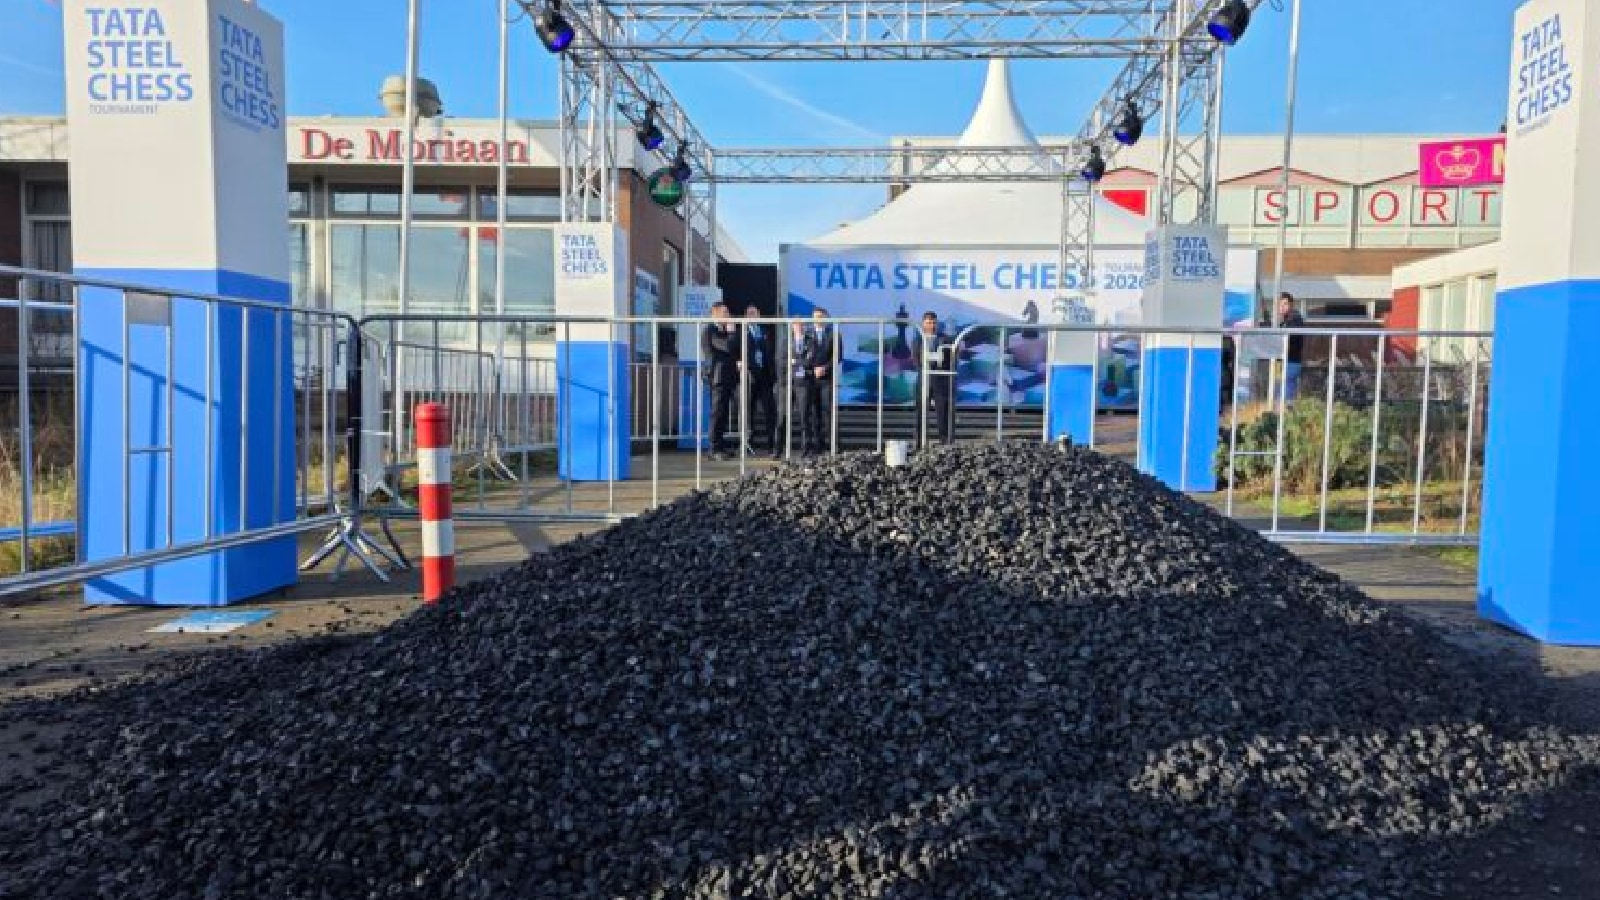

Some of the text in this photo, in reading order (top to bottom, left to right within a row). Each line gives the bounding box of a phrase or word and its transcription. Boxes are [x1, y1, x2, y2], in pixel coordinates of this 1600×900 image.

[85, 8, 165, 36] TATA
[219, 15, 263, 64] TATA
[1521, 13, 1561, 60] TATA
[88, 40, 183, 68] STEEL
[1520, 42, 1568, 94] STEEL
[88, 73, 193, 101] CHESS
[220, 48, 273, 99] STEEL
[221, 84, 279, 129] CHESS
[1517, 73, 1572, 125] CHESS
[299, 128, 530, 163] De Moriaan
[1264, 190, 1498, 223] SPORT
[562, 235, 596, 247] TATA
[562, 248, 602, 260] STEEL
[1173, 236, 1209, 249] TATA
[562, 261, 608, 273] CHESS
[1173, 250, 1216, 263] STEEL
[809, 262, 885, 290] TATA
[893, 262, 986, 290] STEEL
[1173, 265, 1219, 277] CHESS
